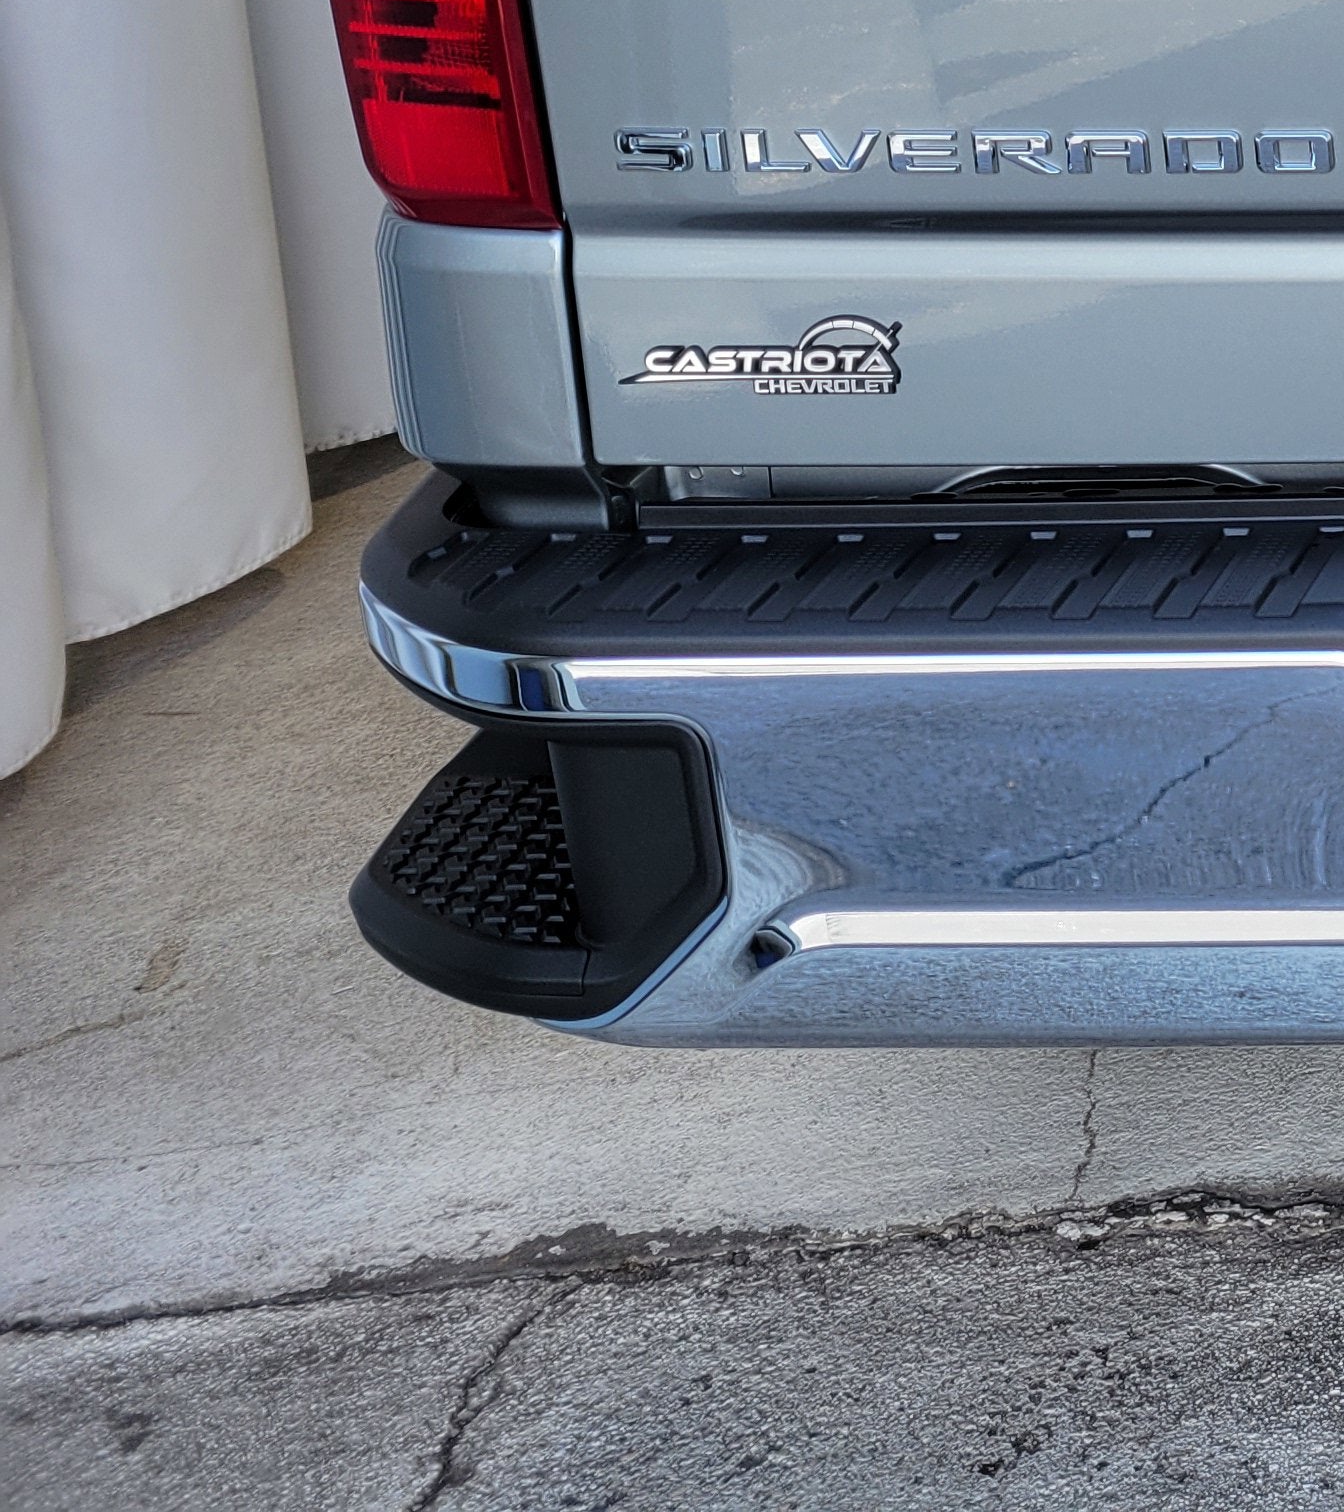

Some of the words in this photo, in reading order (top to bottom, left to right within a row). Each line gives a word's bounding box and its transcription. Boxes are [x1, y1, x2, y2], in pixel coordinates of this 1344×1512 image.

[613, 126, 1337, 175] SILVERADO
[644, 343, 894, 374] CASTRIOTA
[753, 378, 895, 394] CHEVROLET
